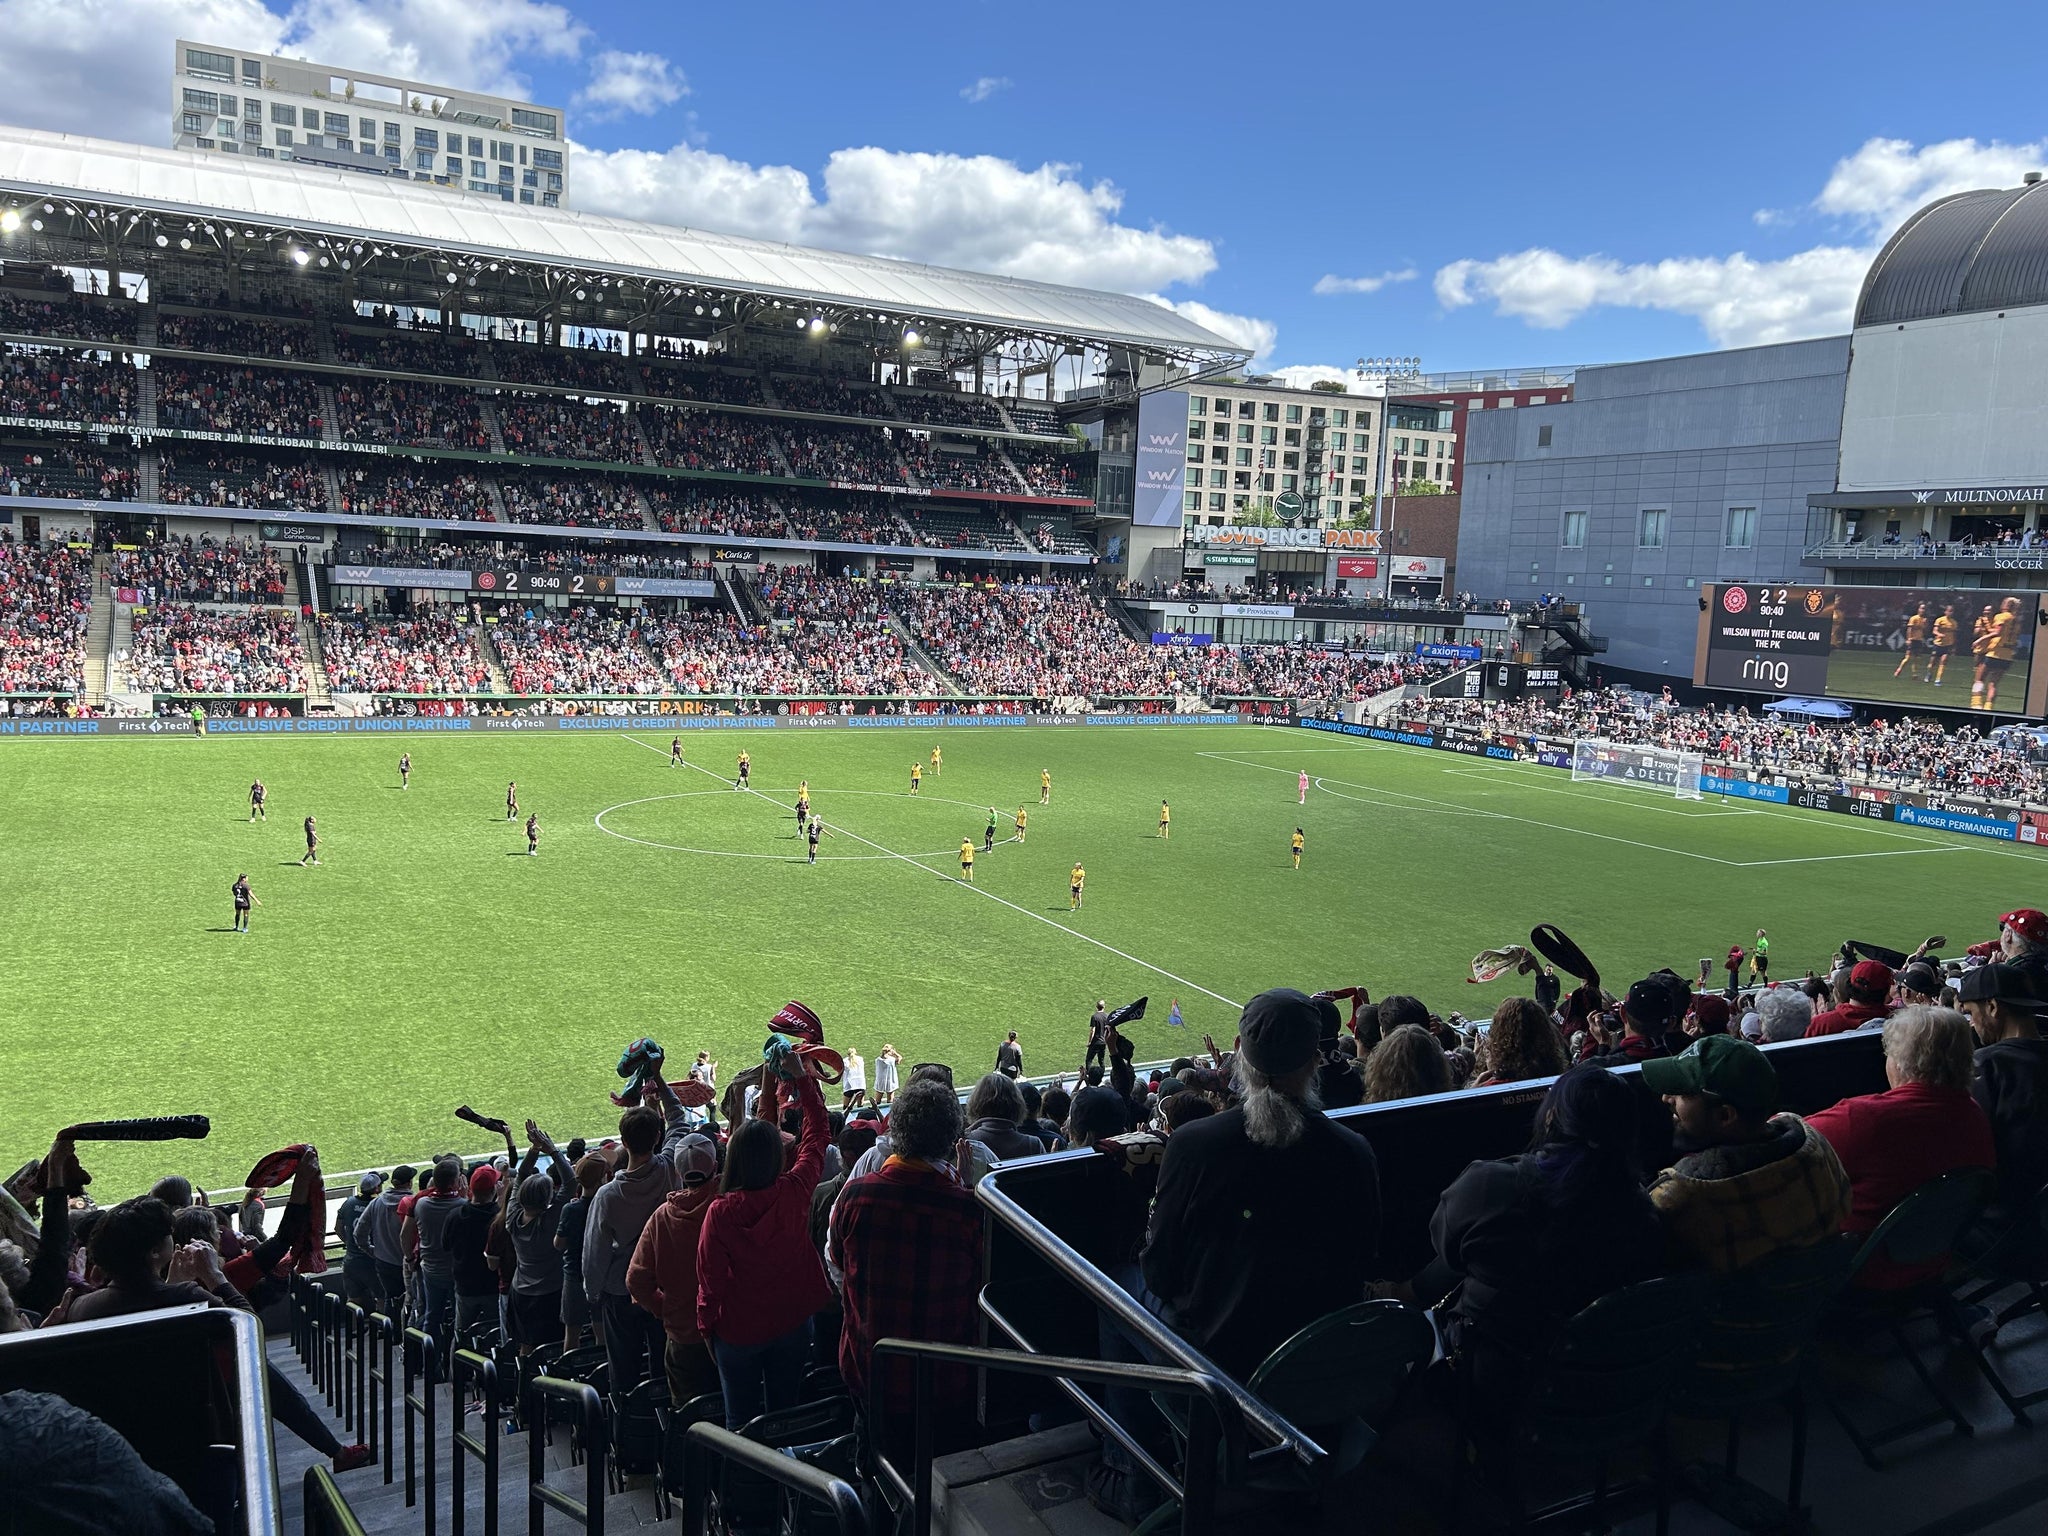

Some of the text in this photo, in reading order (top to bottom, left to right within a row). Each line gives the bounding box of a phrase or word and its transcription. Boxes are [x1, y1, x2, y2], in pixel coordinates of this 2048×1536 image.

[28, 418, 81, 430] CHARLES
[89, 423, 125, 434] JIMMY
[128, 426, 173, 437] CONWAY
[181, 430, 222, 441] TIMBER
[224, 433, 243, 442] JIM
[250, 435, 275, 445] MICK
[278, 437, 313, 448] HOBAN
[320, 441, 350, 451] DIEGO
[352, 443, 387, 453] VALERI
[880, 486, 907, 494] CHRISTINE
[1944, 488, 2044, 503] MULTNOMAH
[284, 526, 304, 535] DSP
[1193, 524, 1384, 548] PROVIDENCE PARK
[1994, 560, 2043, 570] SOCCER
[506, 573, 584, 593] 2 90:40 2
[1760, 589, 1787, 604] 2 2
[1760, 606, 1783, 616] 90:40
[1723, 627, 1820, 640] WILSON WITH THE GOAL ON
[1845, 631, 1883, 645] First
[1170, 635, 1194, 644] xfinity
[1755, 639, 1780, 649] THE PK
[1432, 646, 1459, 656] axiom
[1527, 670, 1558, 679] PUB BEER
[1743, 654, 1789, 688] ring
[1465, 676, 1480, 685] PUB
[208, 719, 472, 731] EXCLUSIVE CREDIT UNION PARTNER
[487, 720, 509, 728] First
[560, 718, 776, 729] EXCLUSIVE CREDIT UNION PARTNER
[849, 717, 1026, 726] EXCLUSIVE CREDIT UNION PARTNER
[1087, 715, 1238, 725] EXCLUSIVE CREDIT UNION PARTNER
[20, 721, 98, 733] PARTNER
[119, 722, 189, 730] First Tech
[1301, 719, 1433, 746] EXCLUSIVE CREDIT UNION PARTNER
[1441, 740, 1478, 752] First Tech
[1547, 745, 1568, 754] TOYOTA
[1542, 753, 1558, 766] ally
[1758, 788, 1776, 796] AT&T
[1798, 792, 1816, 806] elf
[1850, 800, 1868, 815] elf
[1944, 803, 1979, 816] TOYOTA
[1918, 815, 2009, 837] KAISER PERMANENTE
[1502, 1096, 1515, 1105] NO
